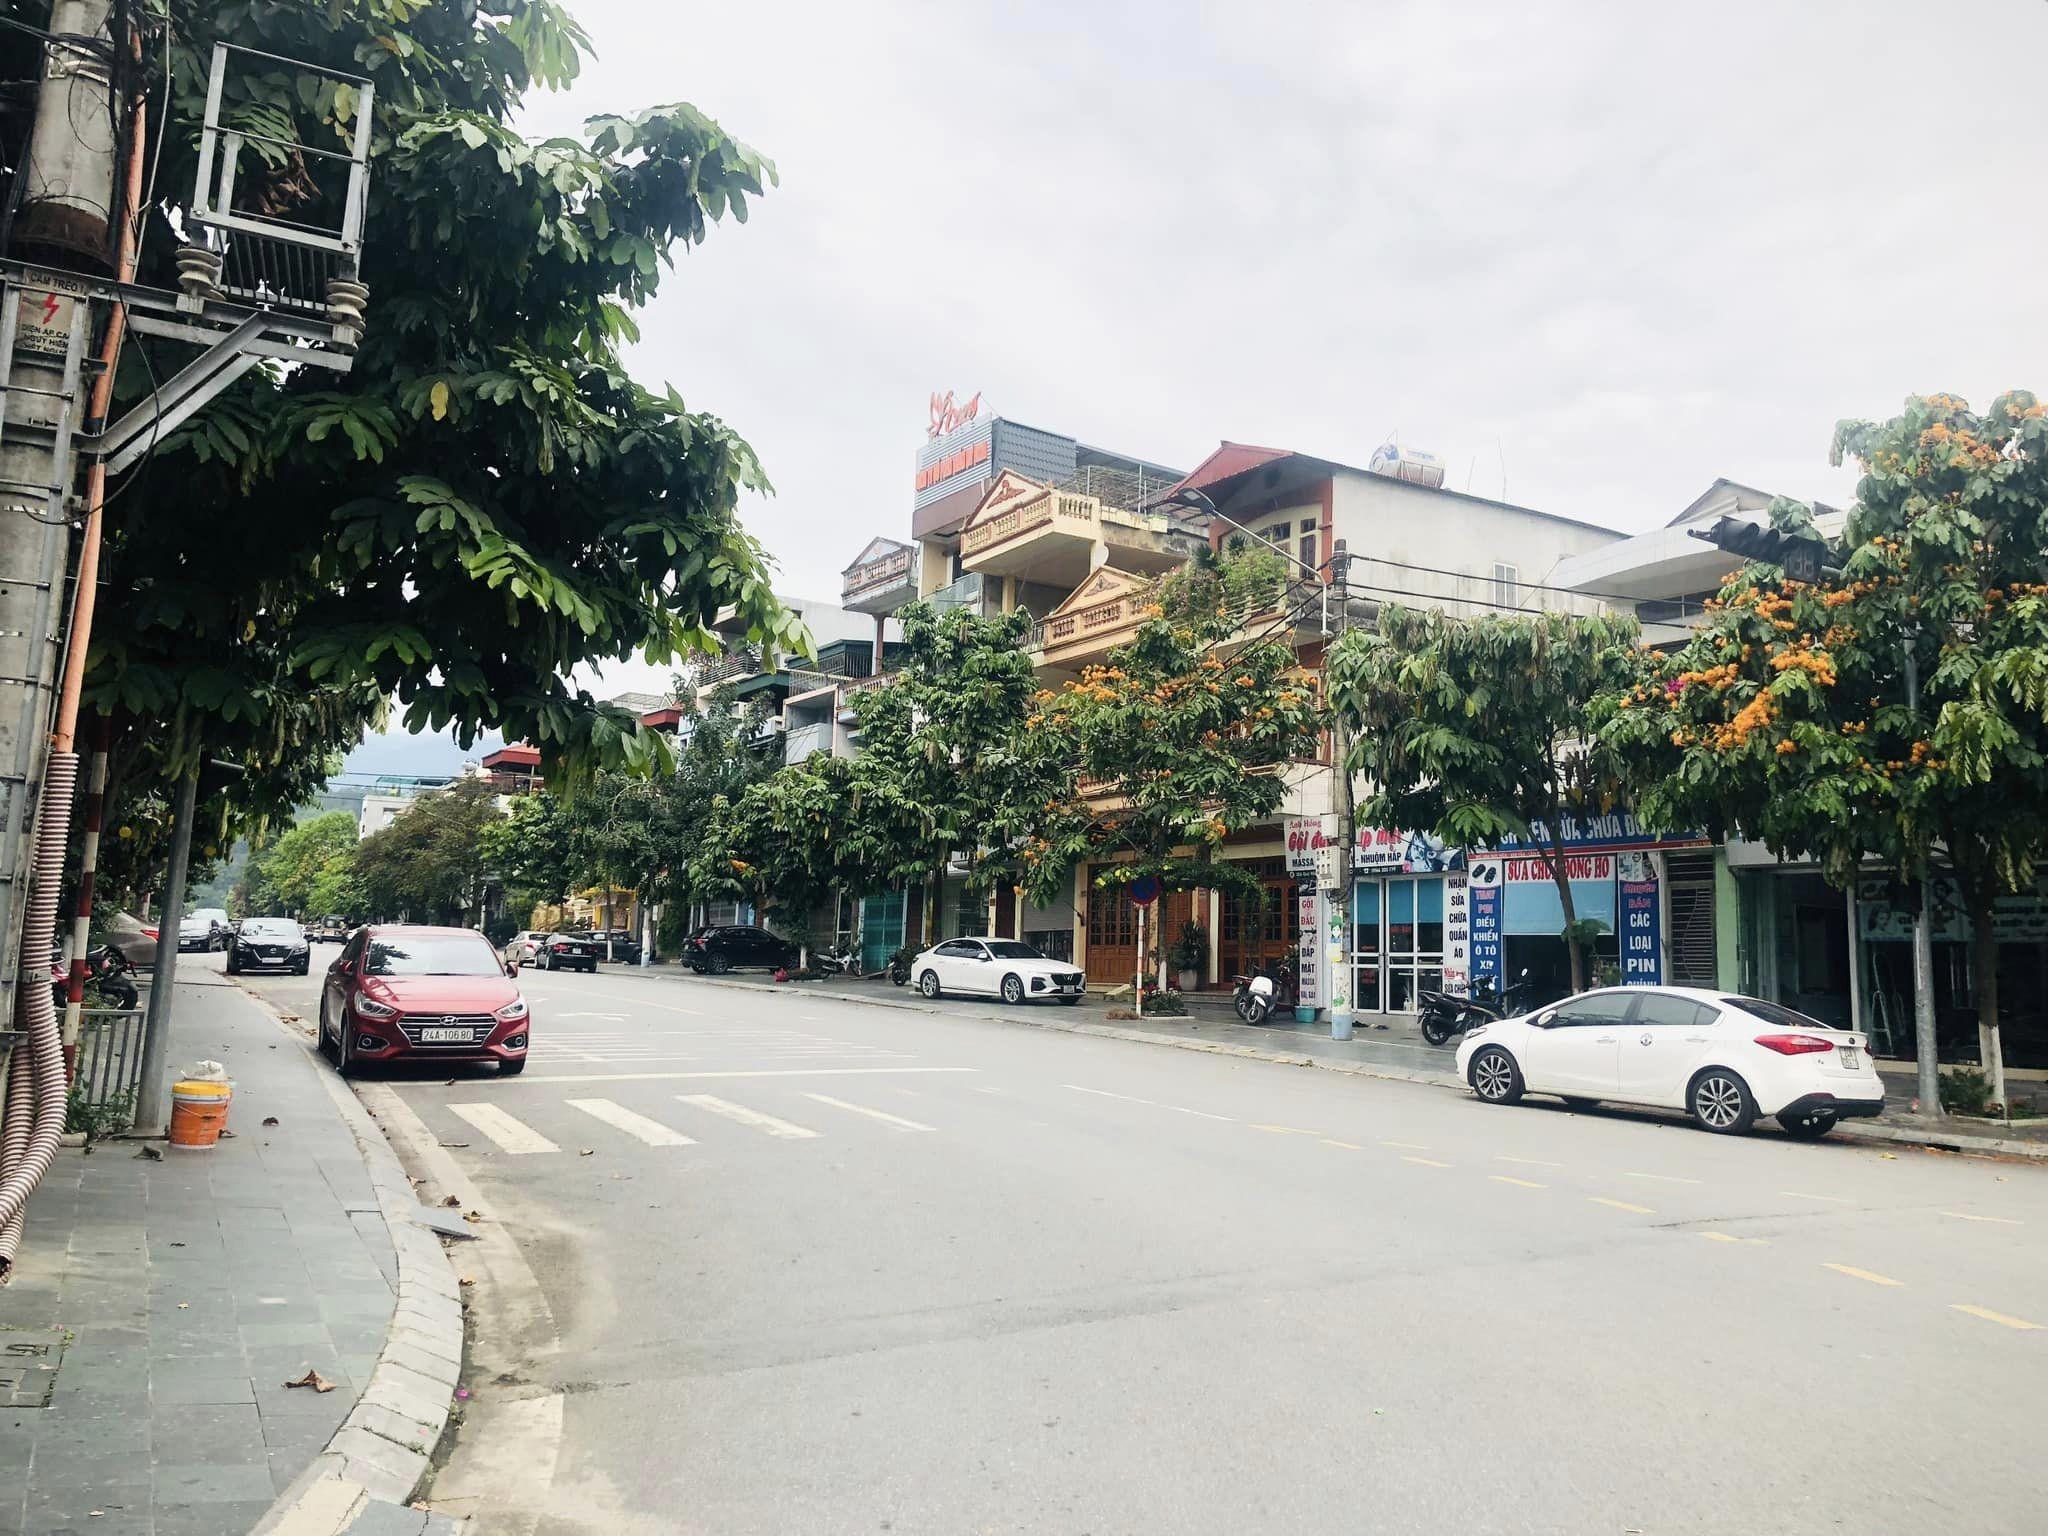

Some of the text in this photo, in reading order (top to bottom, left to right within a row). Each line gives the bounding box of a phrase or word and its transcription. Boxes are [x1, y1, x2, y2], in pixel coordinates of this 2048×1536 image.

[1630, 911, 1650, 927] CÁC
[1629, 935, 1652, 953] LOẠI
[1627, 958, 1655, 973] PIN
